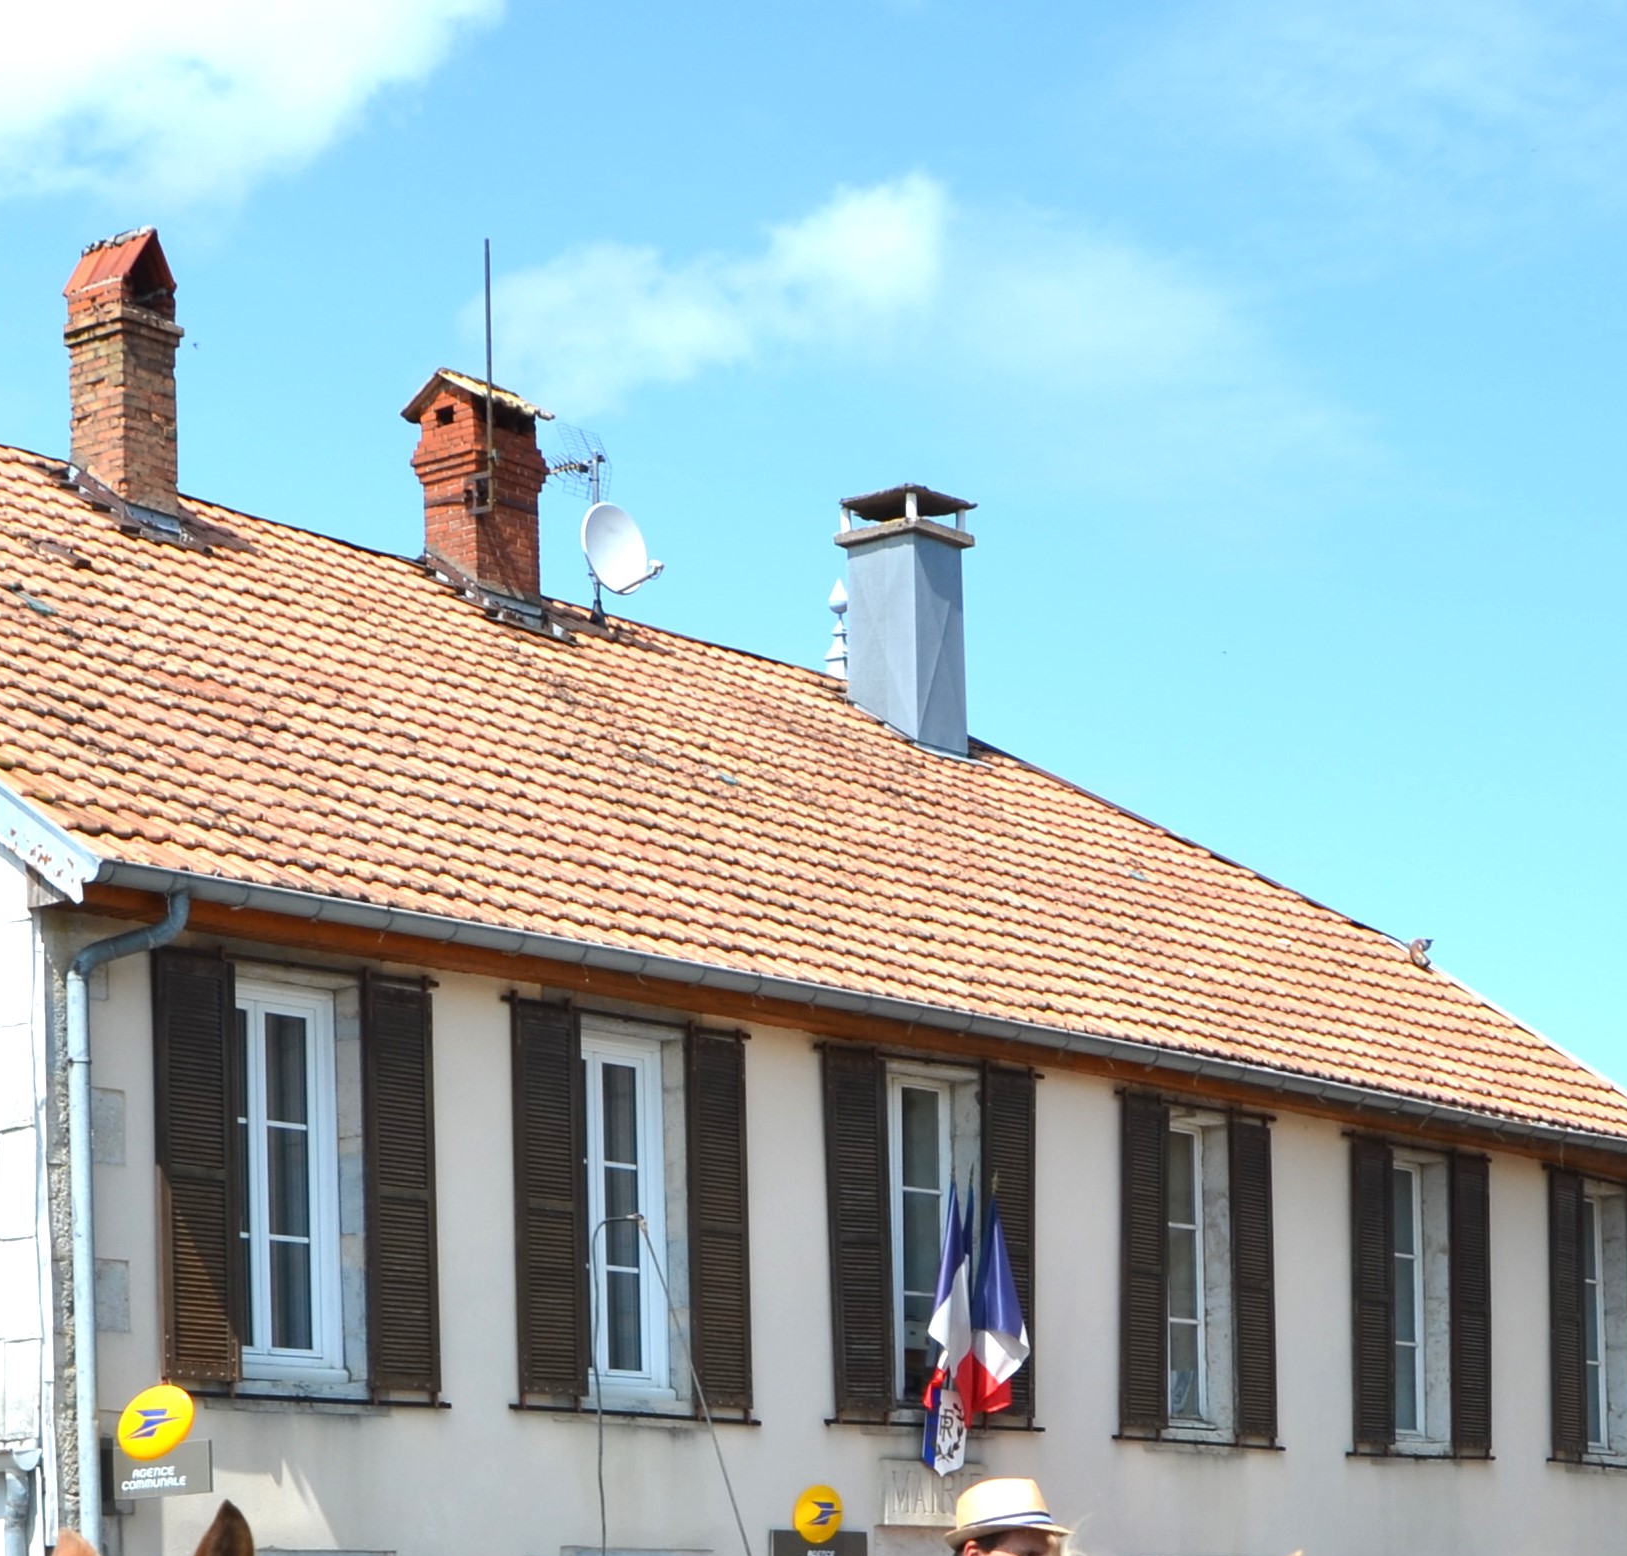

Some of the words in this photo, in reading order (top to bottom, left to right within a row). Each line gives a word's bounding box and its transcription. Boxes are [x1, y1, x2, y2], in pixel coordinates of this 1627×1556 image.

[132, 1465, 176, 1479] AGENCE
[121, 1475, 187, 1491] COMMUNALE
[892, 1470, 984, 1514] MAIR
